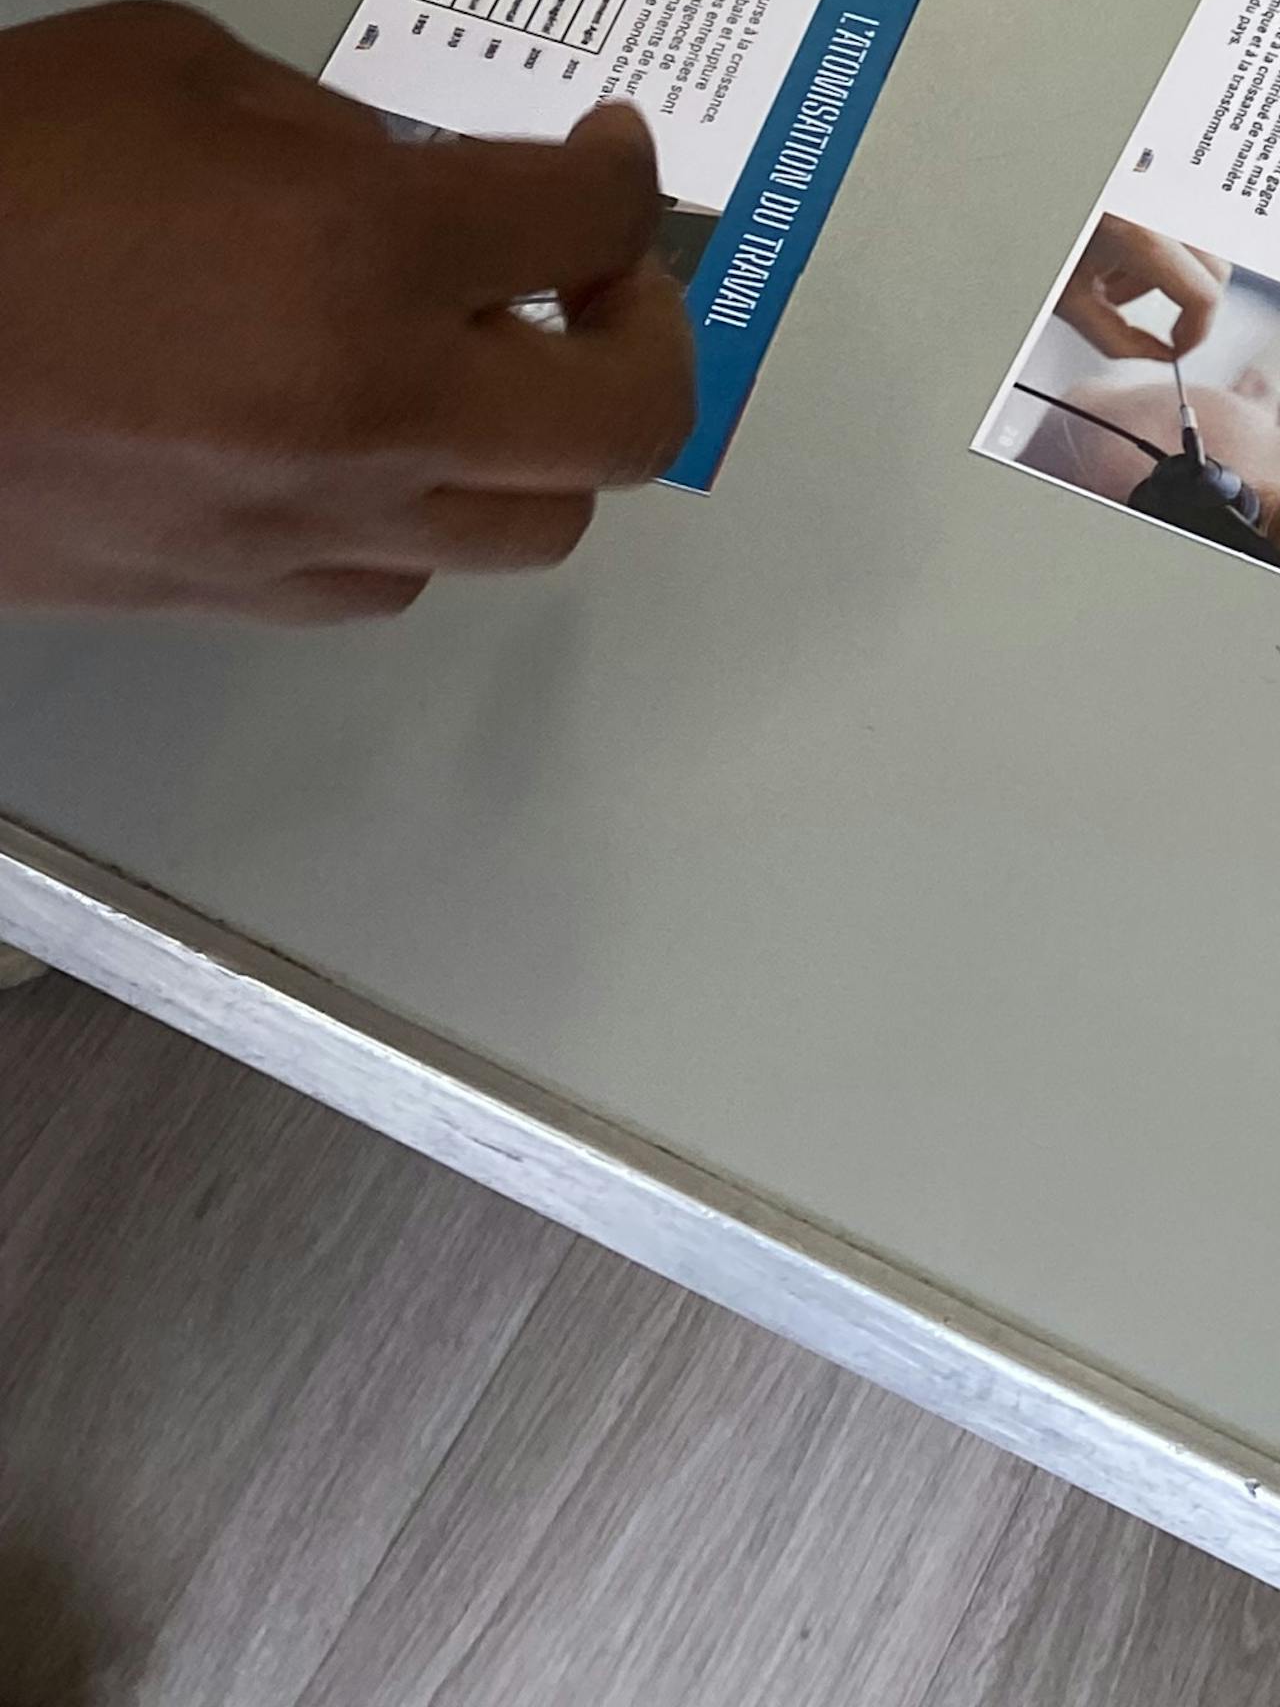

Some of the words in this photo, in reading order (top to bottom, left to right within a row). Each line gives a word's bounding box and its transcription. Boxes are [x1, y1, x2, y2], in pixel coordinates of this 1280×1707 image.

[717, 25, 733, 41] et
[735, 37, 754, 51] la
[742, 25, 759, 36] à
[1227, 13, 1251, 45] pays.
[1248, 34, 1262, 49] et
[693, 41, 726, 91] rupture
[1236, 58, 1253, 72] la
[1243, 48, 1258, 58] à
[1262, 50, 1279, 64] la
[698, 52, 744, 124] croissance,
[768, 11, 880, 190] L'ATOMISATION
[1228, 64, 1269, 131] croissance
[1189, 73, 1245, 166] transformation
[1247, 120, 1264, 138] de
[1220, 138, 1255, 192] manière
[1240, 164, 1264, 197] mais
[751, 190, 801, 230] DU
[1253, 174, 1280, 216] gagné
[703, 232, 784, 328] TRAVAIL
